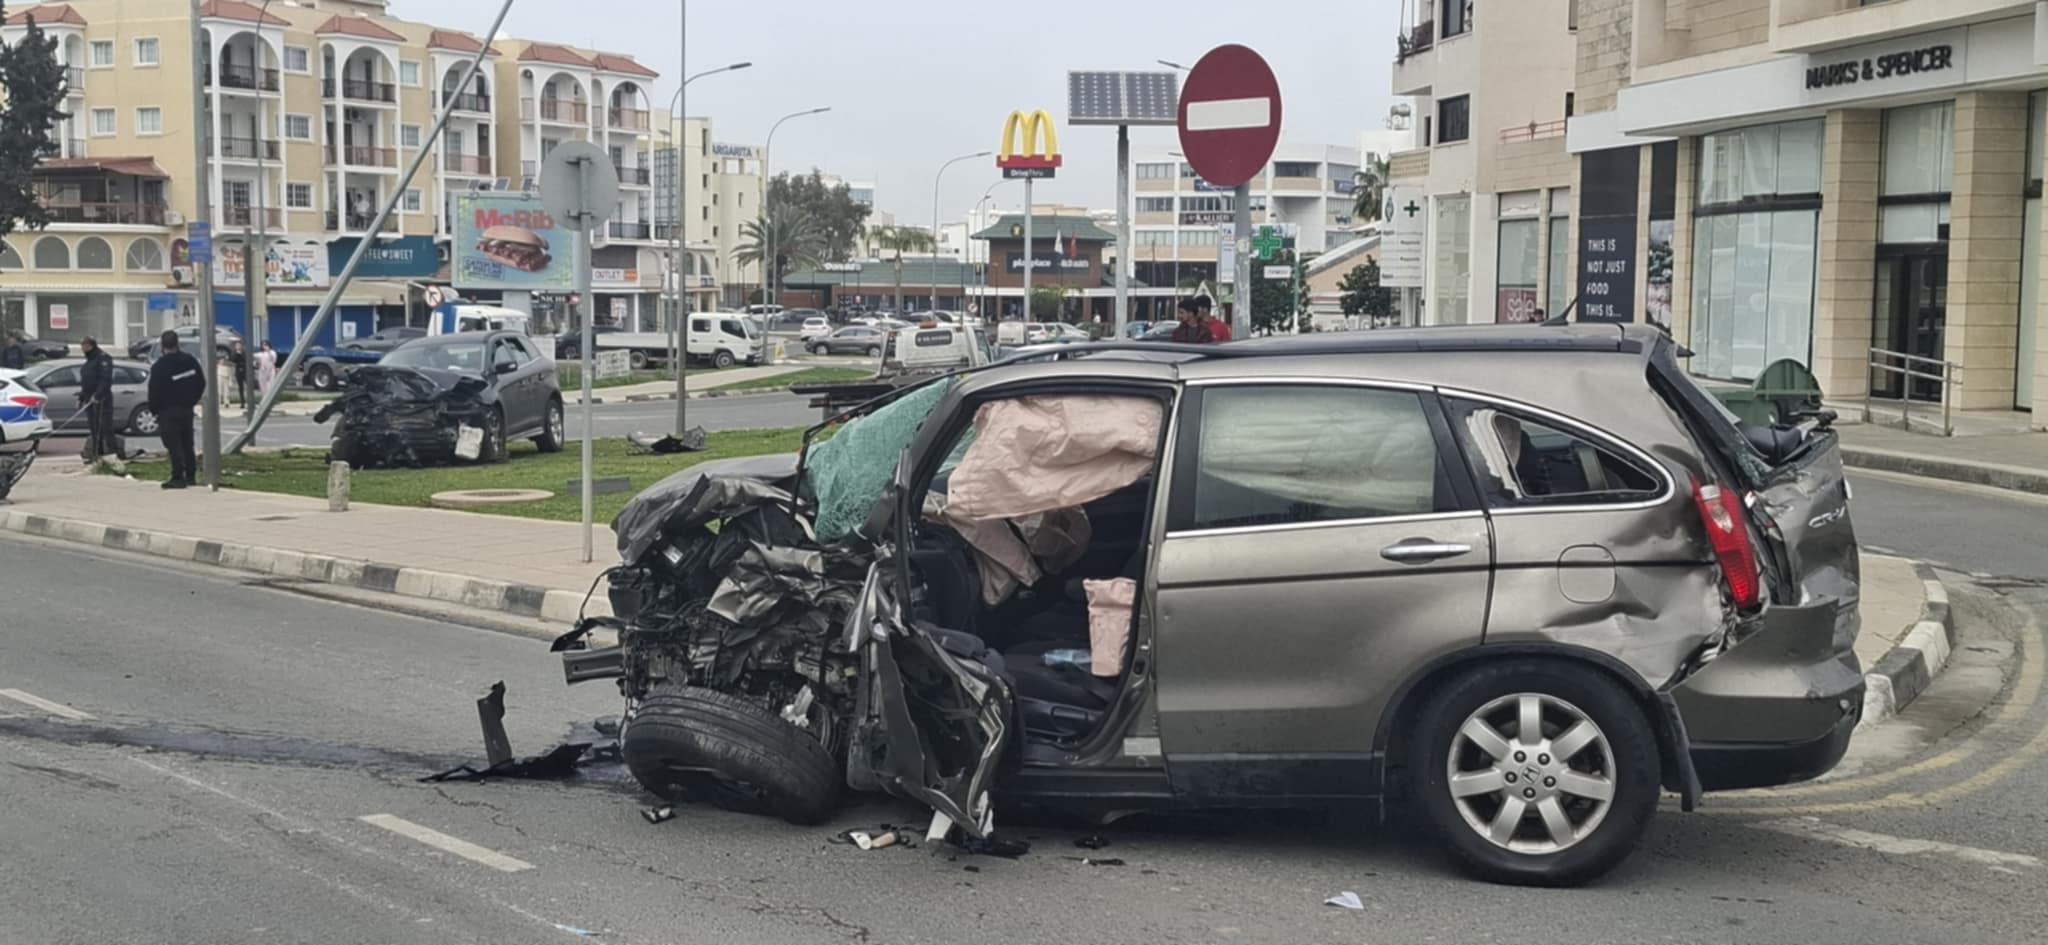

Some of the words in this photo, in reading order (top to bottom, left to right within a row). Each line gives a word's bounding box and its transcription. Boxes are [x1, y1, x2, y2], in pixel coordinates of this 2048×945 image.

[1806, 61, 1858, 89] MARKS
[1862, 59, 1873, 80] &
[1877, 45, 1952, 78] SPENCER
[712, 144, 752, 157] ARGARITA
[475, 208, 554, 230] McRib
[1588, 239, 1605, 251] THIS
[1608, 239, 1616, 251] IS
[1587, 261, 1603, 272] NOT
[1605, 261, 1626, 272] JUST
[1586, 282, 1609, 295] FOOD
[1586, 304, 1603, 316] THIS
